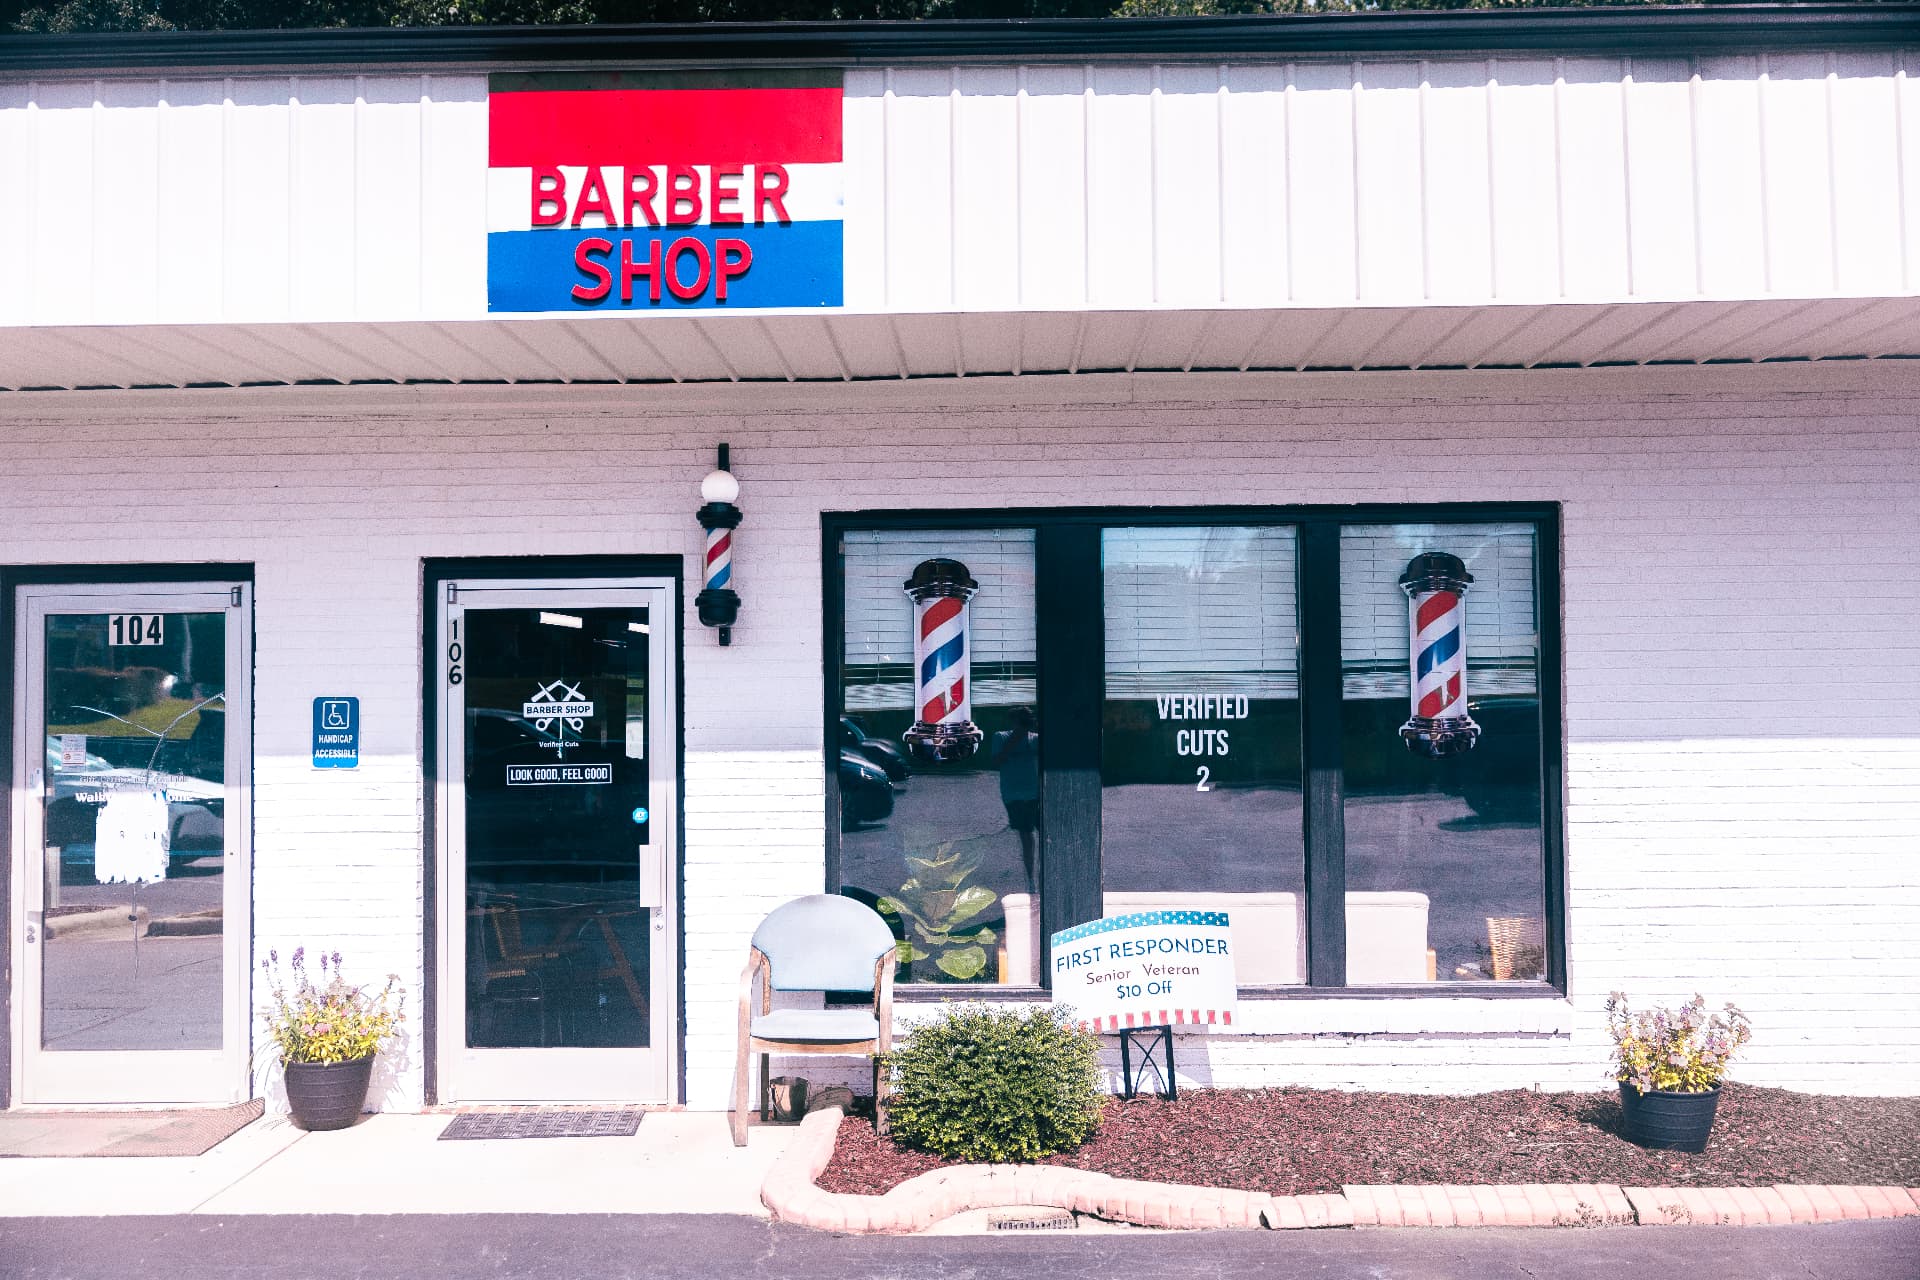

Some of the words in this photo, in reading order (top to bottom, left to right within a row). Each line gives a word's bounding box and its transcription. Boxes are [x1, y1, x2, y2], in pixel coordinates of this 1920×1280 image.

[531, 164, 791, 227] BARBER
[571, 237, 752, 300] SHOP
[113, 616, 161, 644] 104
[449, 620, 462, 685] 106
[526, 706, 563, 714] BARBER
[566, 705, 591, 714] SHOP
[1156, 694, 1249, 719] VERIFIED
[318, 734, 353, 744] HANDICAP
[1177, 729, 1229, 756] CUTS
[315, 748, 357, 758] ACCESSIBLE
[510, 769, 533, 781] LOOK
[534, 768, 561, 782] GOOD,
[562, 768, 583, 780] FEEL
[585, 767, 608, 780] GOOD
[1196, 765, 1210, 792] 2
[1057, 946, 1102, 973] FIRST
[1110, 938, 1229, 959] RESPONDER
[1086, 969, 1131, 985] Senior
[1142, 963, 1200, 977] Veteran
[1117, 983, 1141, 1000] $10
[1147, 980, 1172, 995] Off
